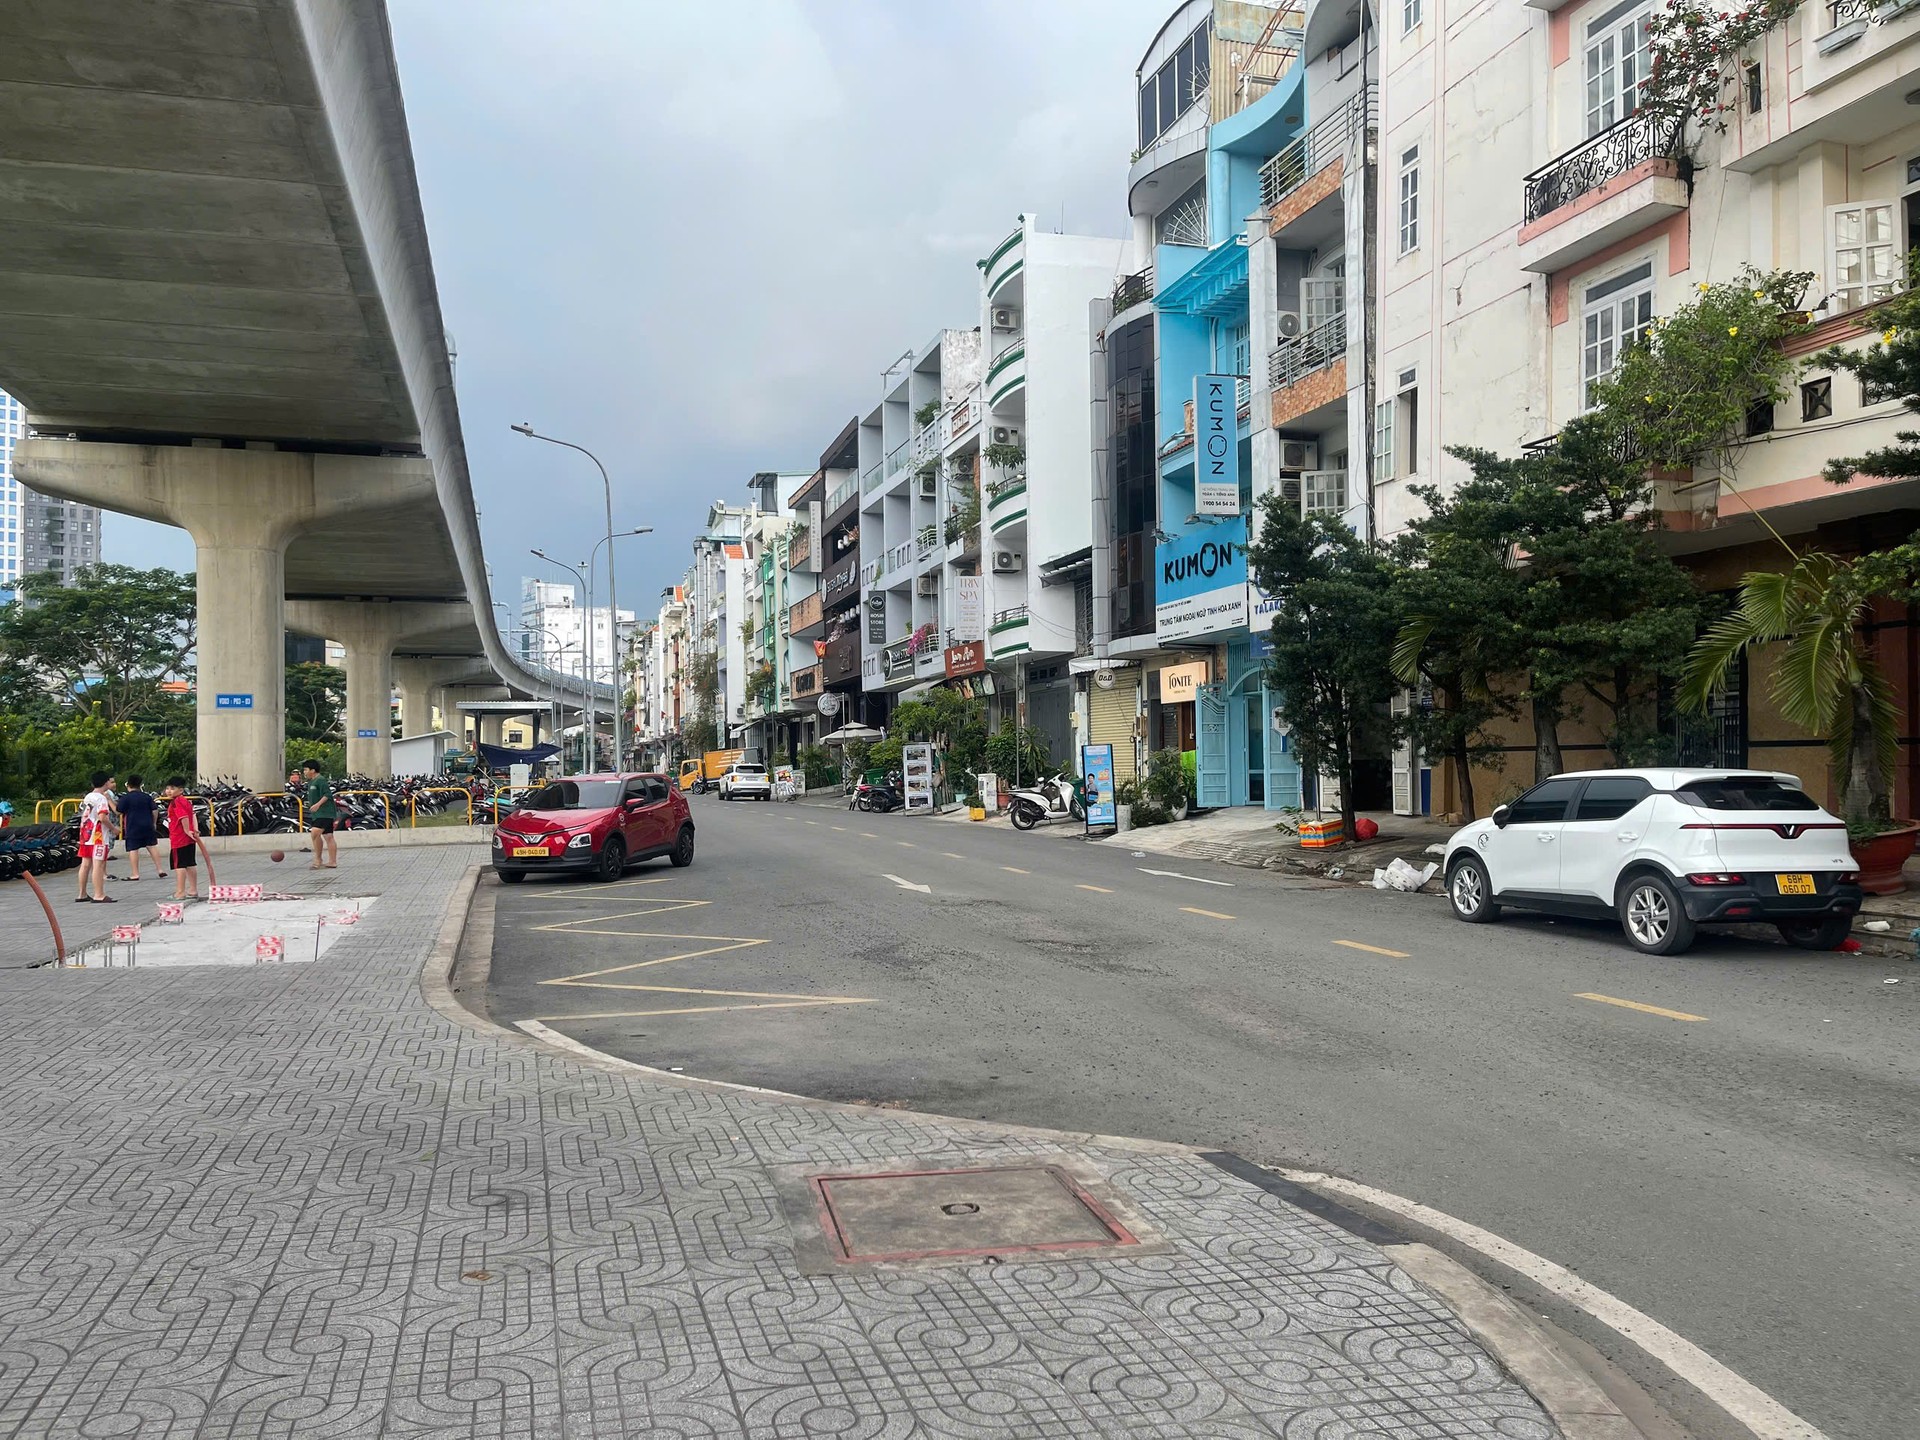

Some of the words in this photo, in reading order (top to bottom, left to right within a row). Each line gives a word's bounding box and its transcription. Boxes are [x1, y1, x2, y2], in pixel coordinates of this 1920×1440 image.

[1208, 383, 1227, 475] KUMON
[1165, 542, 1232, 584] KUMON
[1218, 604, 1228, 613] HOA
[1228, 600, 1242, 612] XANH
[1787, 874, 1804, 884] 68H
